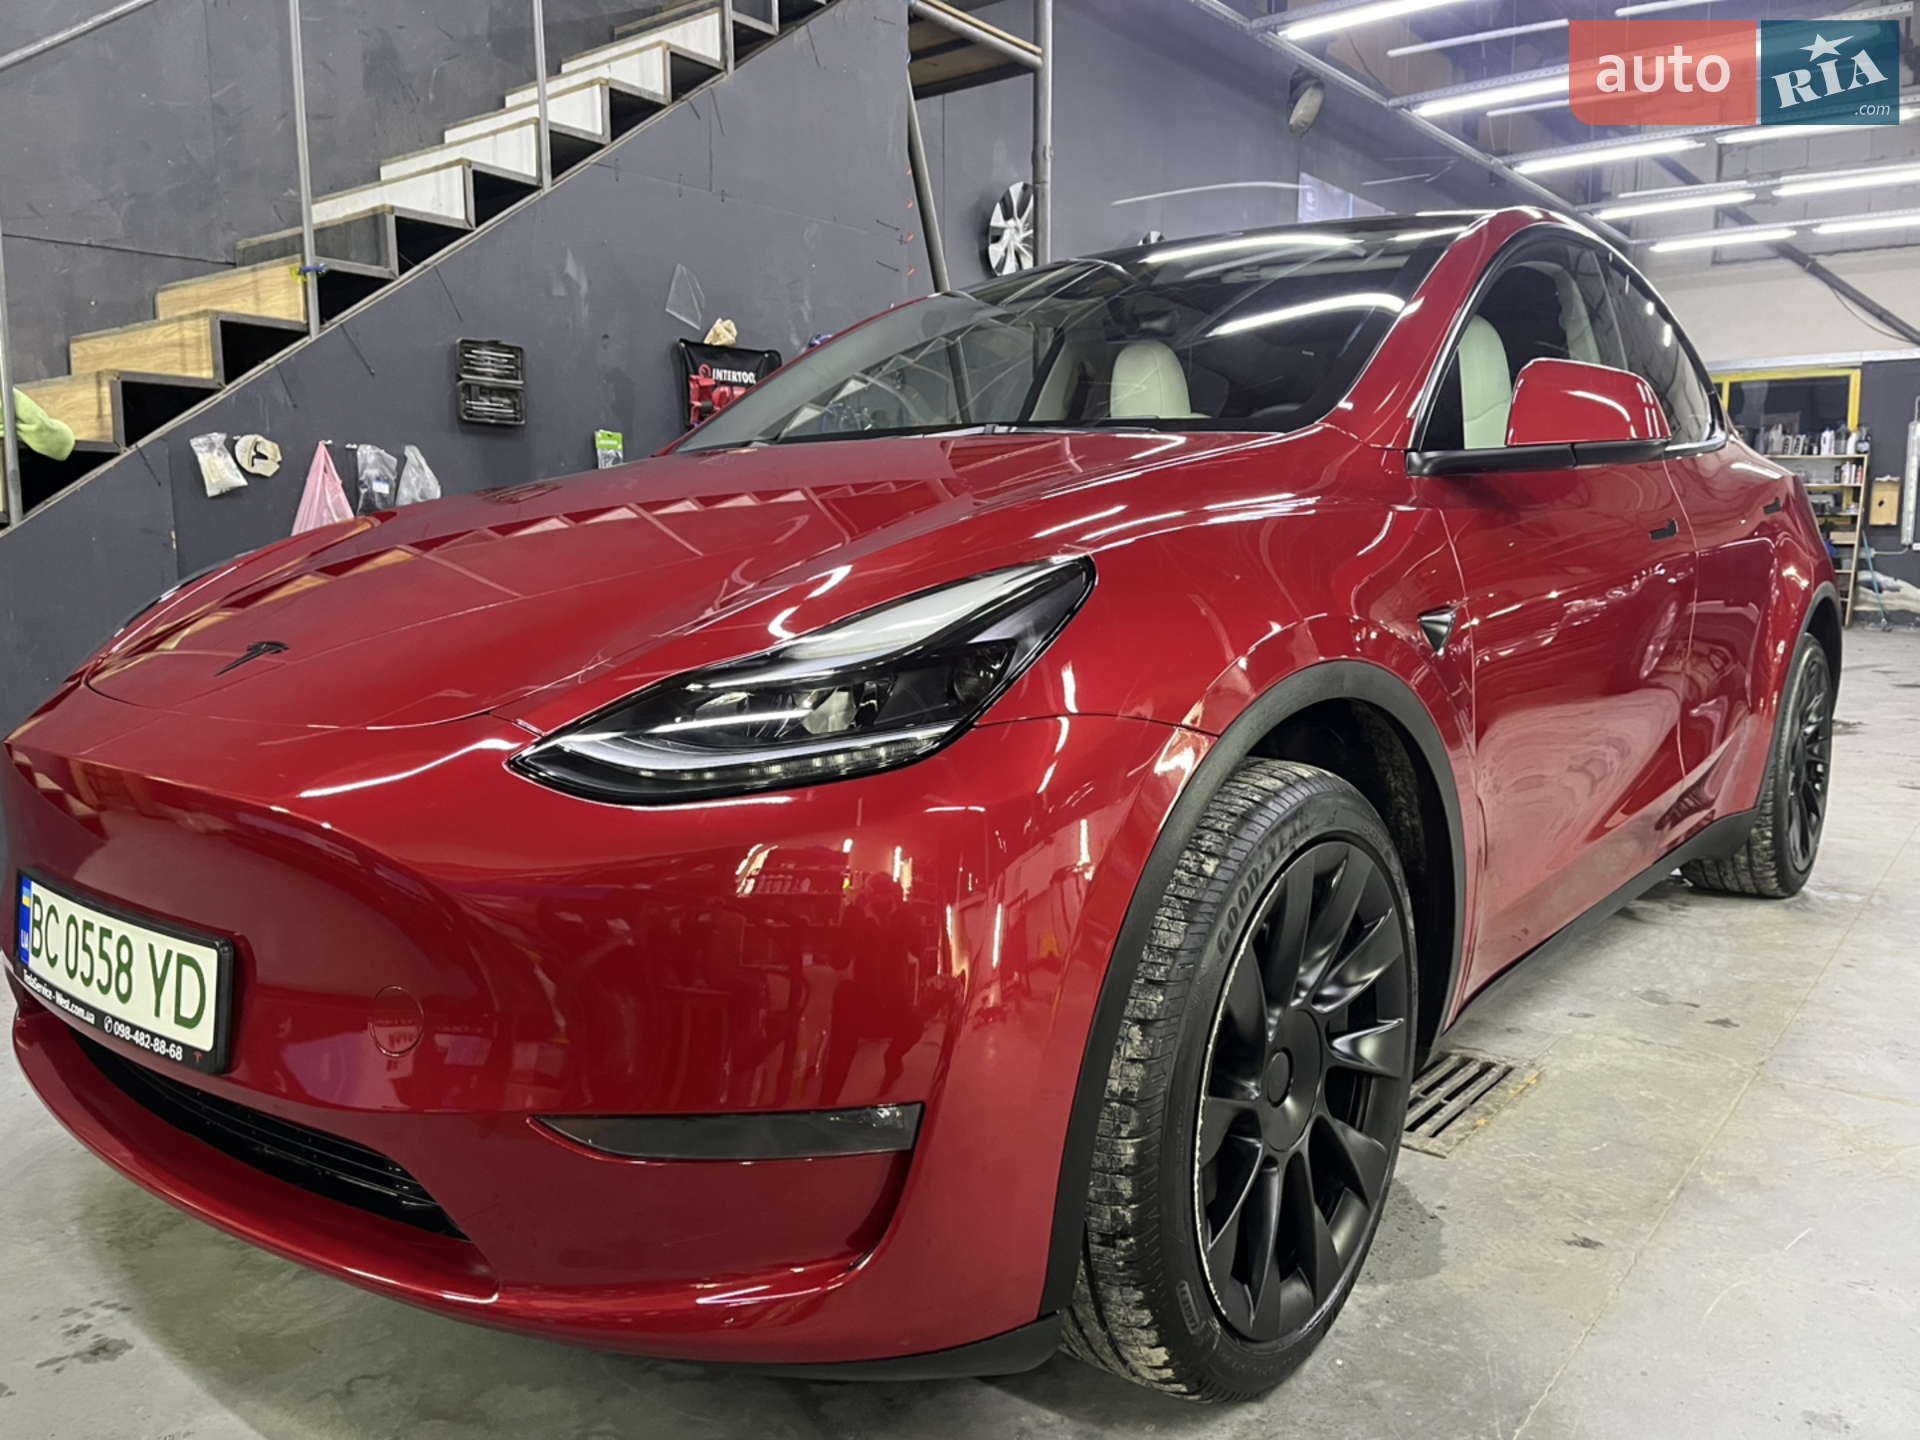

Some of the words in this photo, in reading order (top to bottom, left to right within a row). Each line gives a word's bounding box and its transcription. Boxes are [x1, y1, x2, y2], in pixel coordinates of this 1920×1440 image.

[712, 367, 757, 384] INTERTOOL
[31, 893, 60, 968] BC
[65, 914, 134, 1004] 0558
[148, 943, 207, 1030] YD
[113, 1021, 183, 1061] 098-482-88-68
